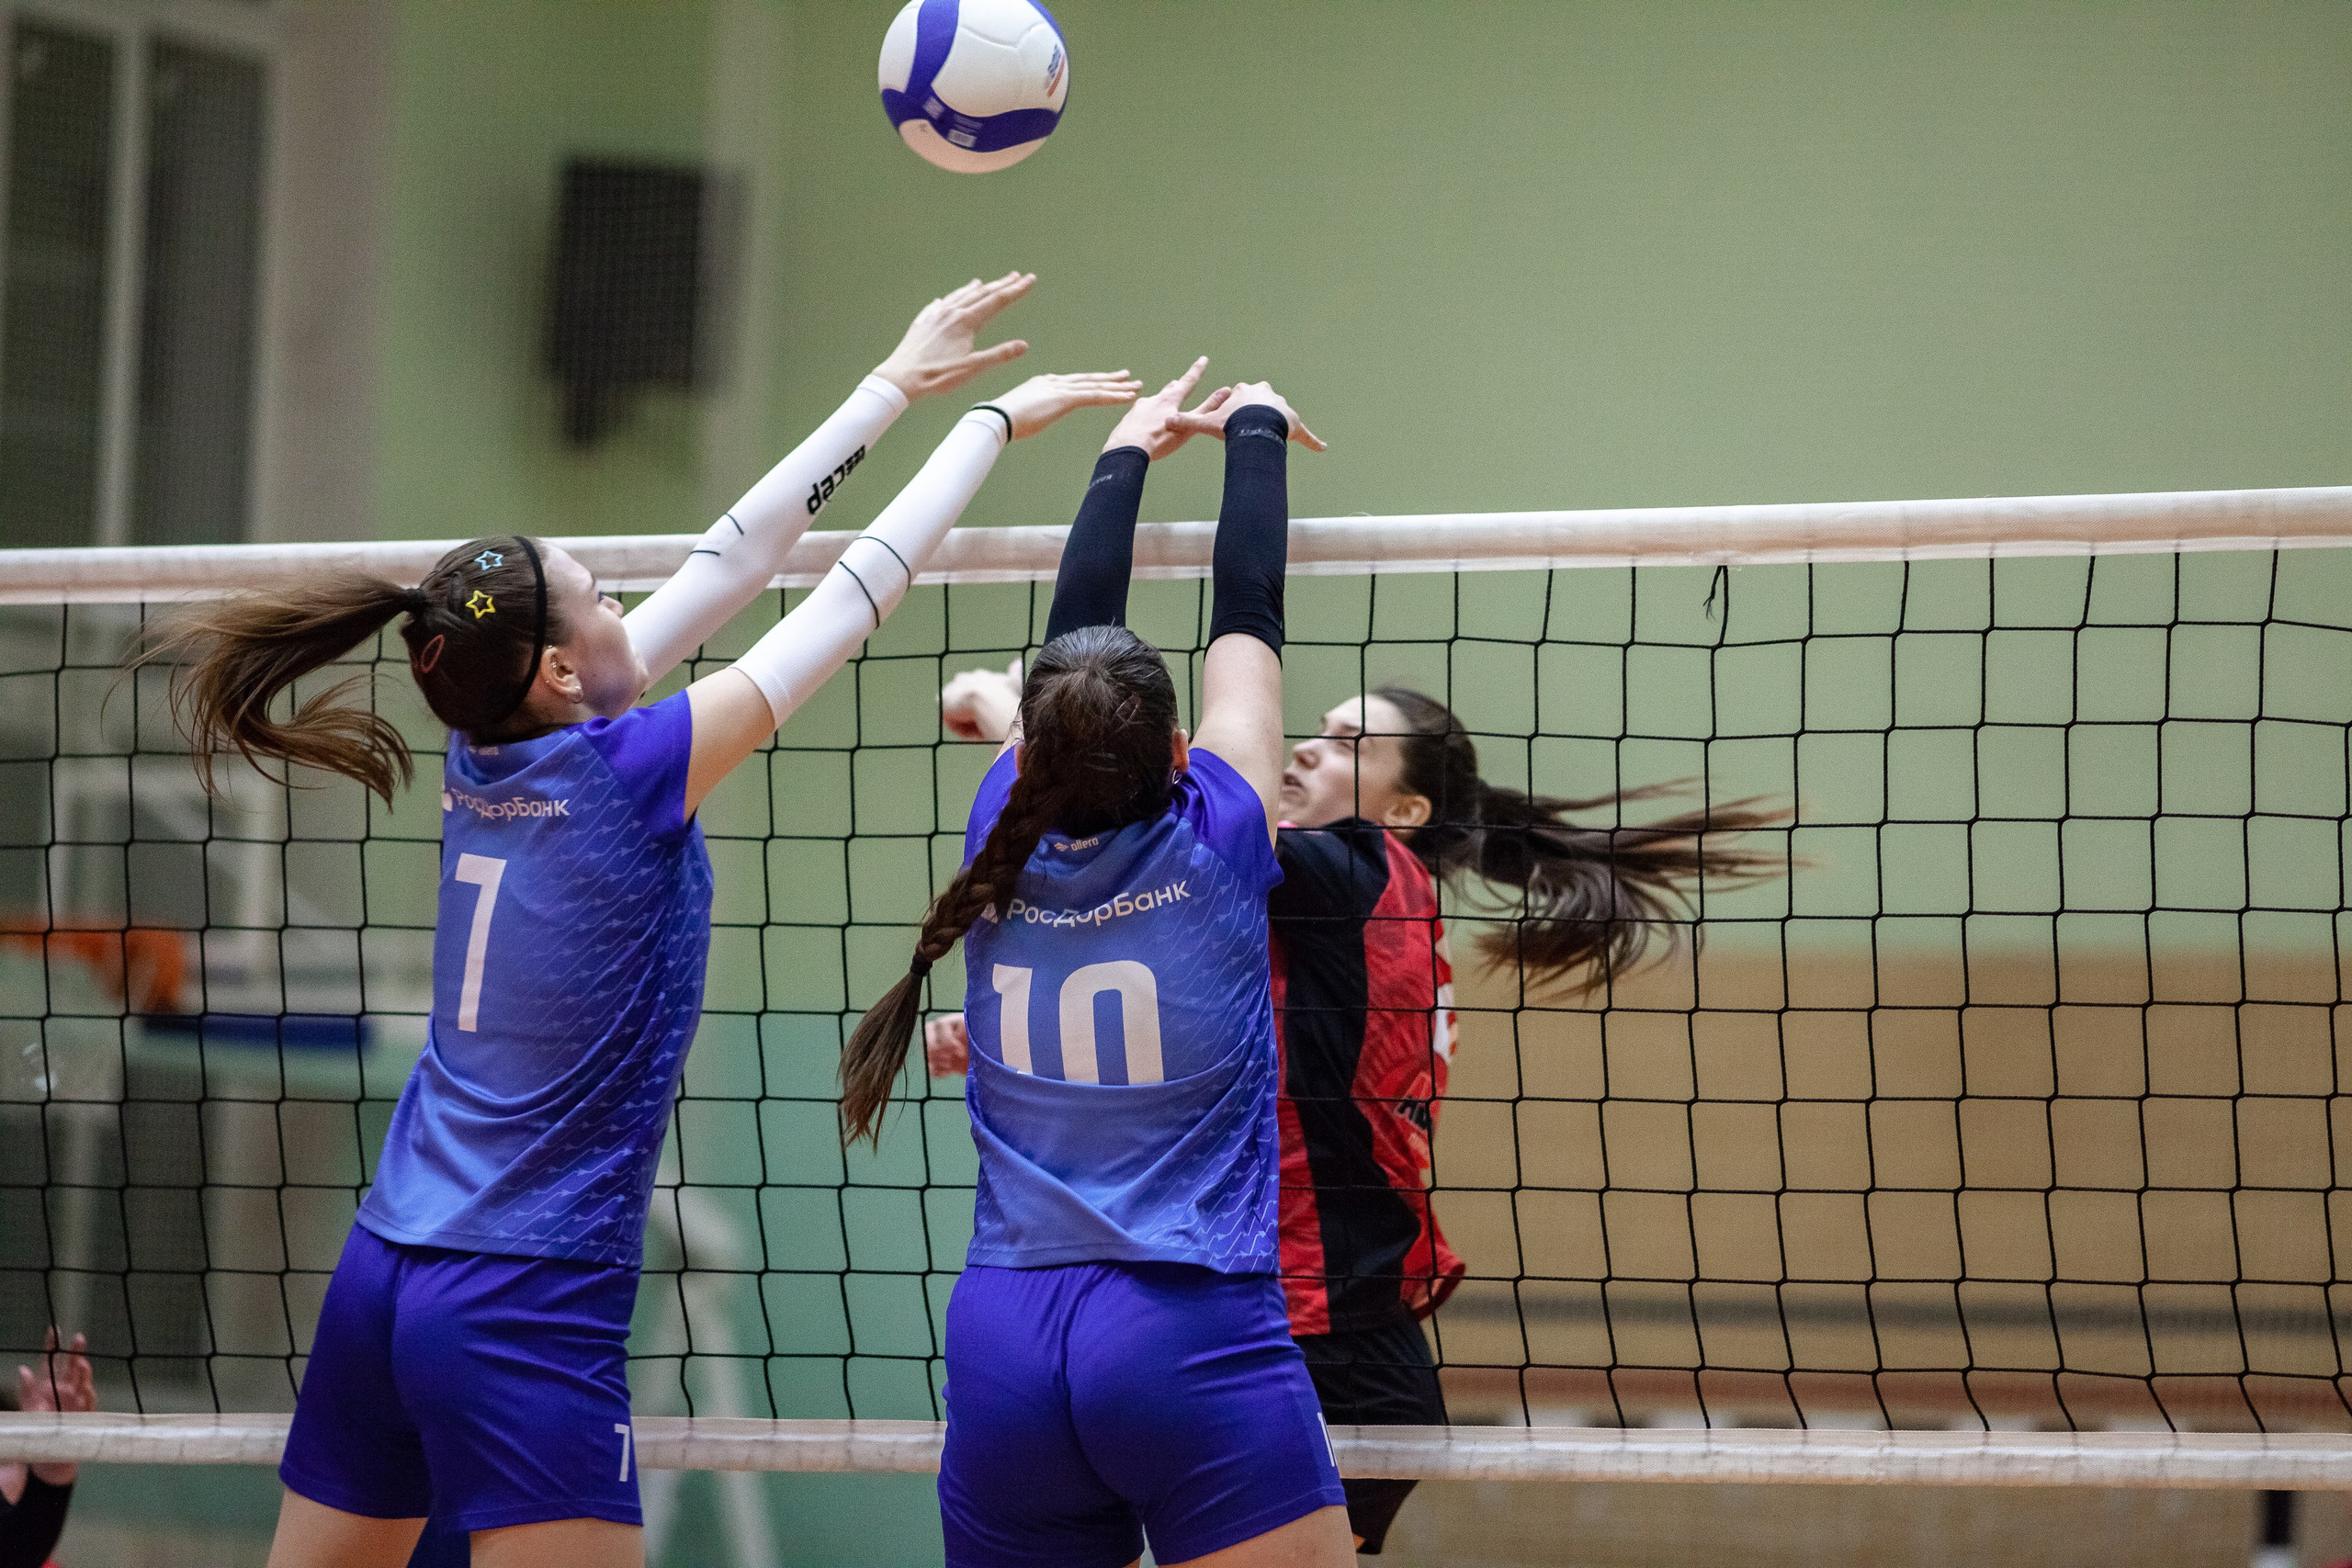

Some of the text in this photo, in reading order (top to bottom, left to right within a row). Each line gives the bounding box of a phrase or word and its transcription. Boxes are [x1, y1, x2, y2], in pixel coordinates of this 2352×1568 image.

[456, 852, 507, 1032] 7
[992, 960, 1165, 1086] 10
[615, 1423, 630, 1482] 7
